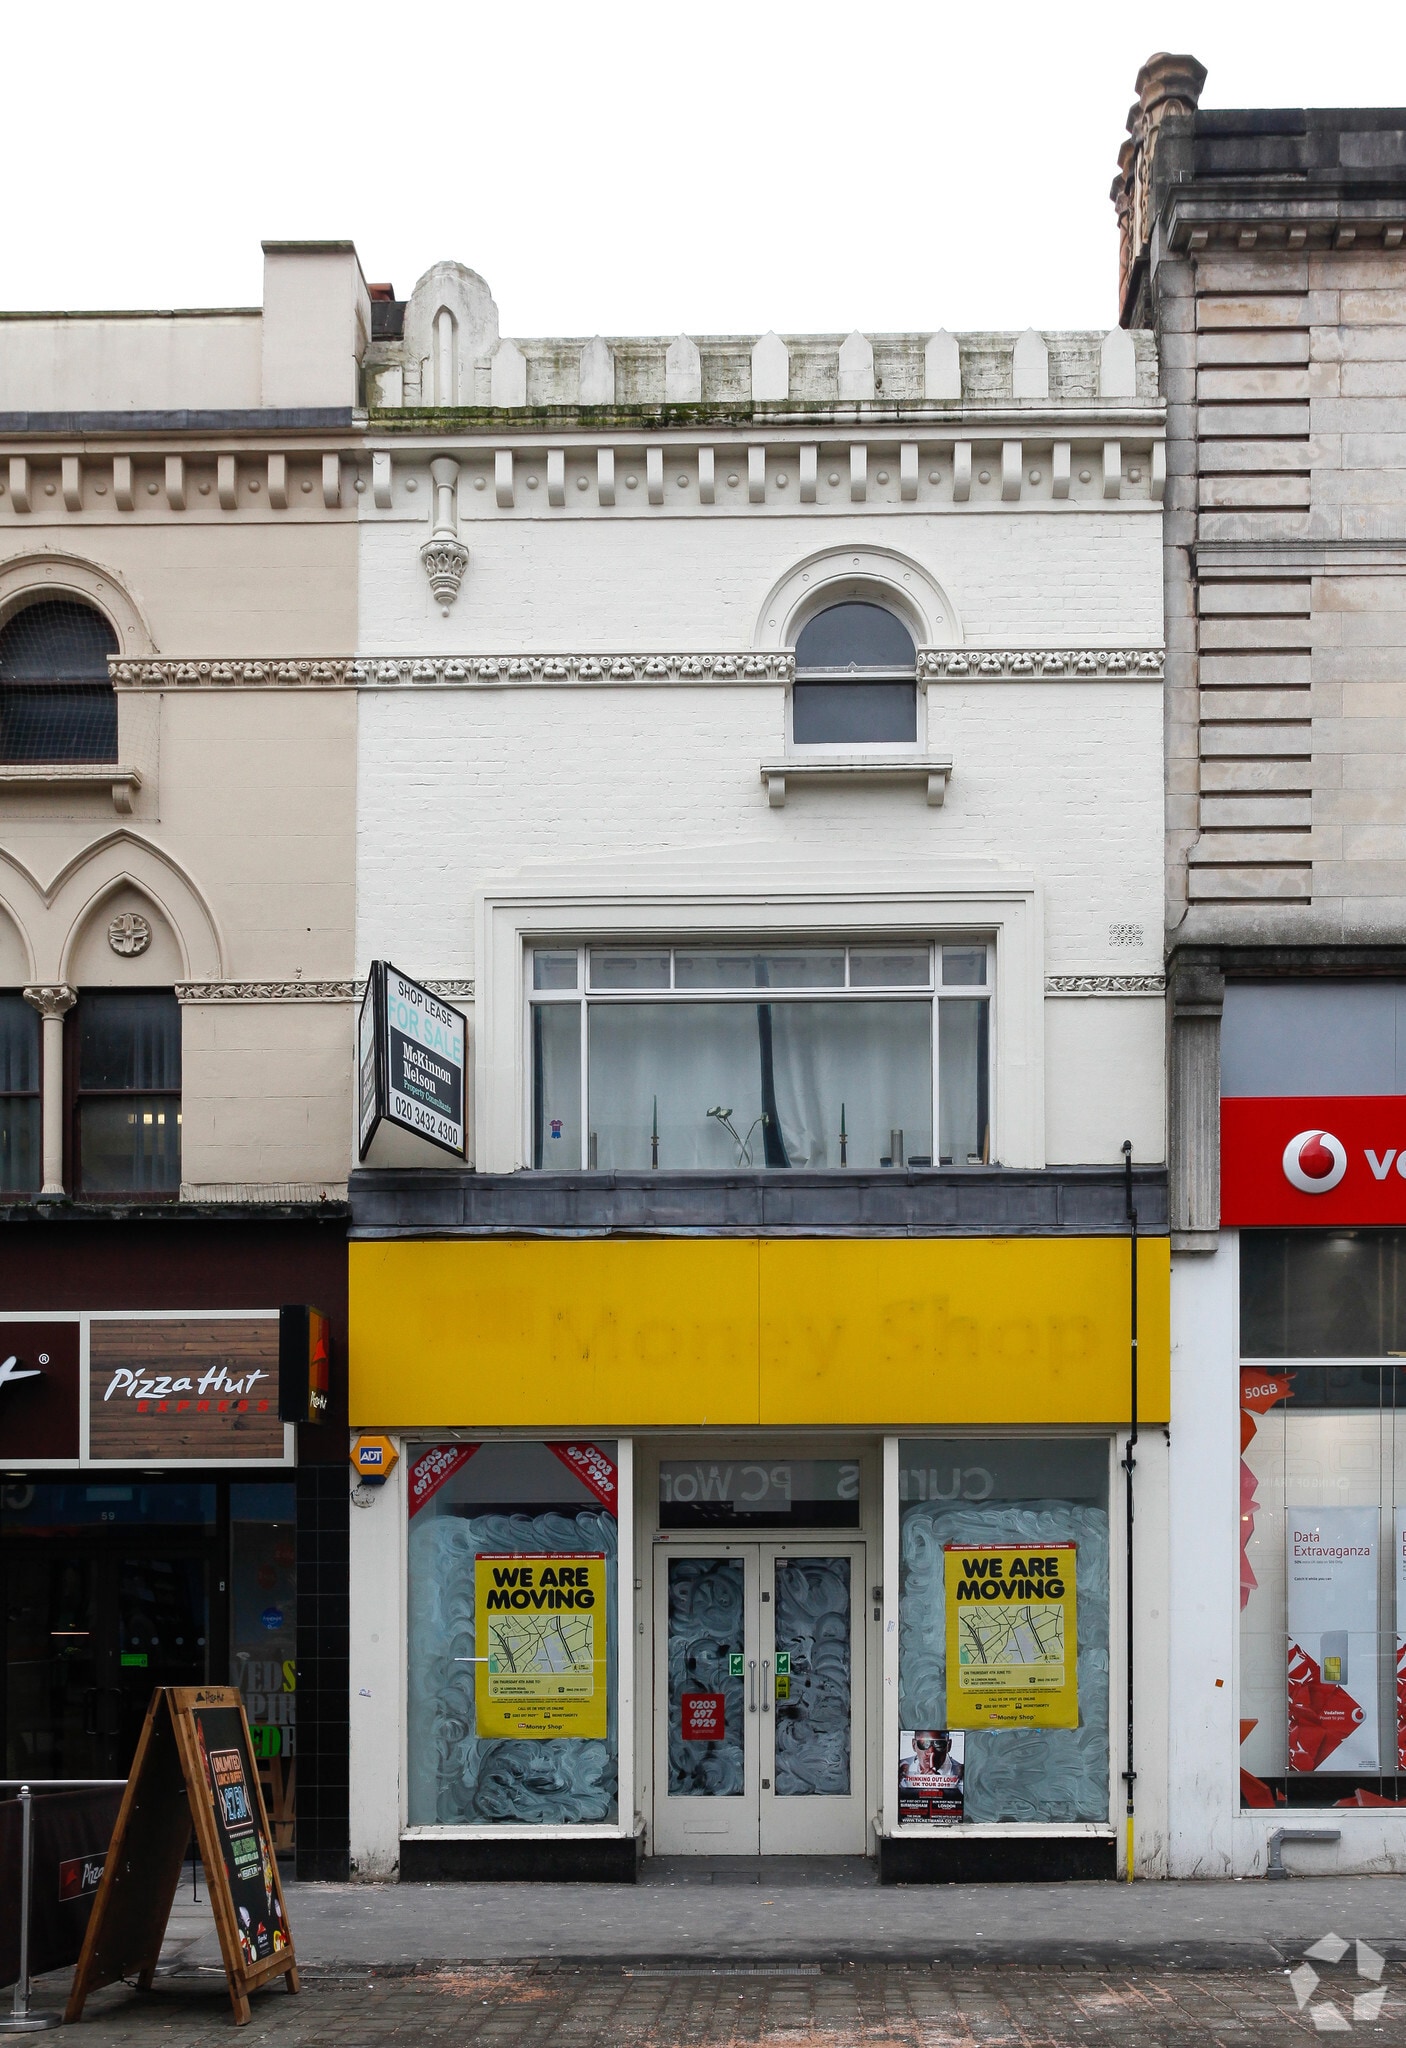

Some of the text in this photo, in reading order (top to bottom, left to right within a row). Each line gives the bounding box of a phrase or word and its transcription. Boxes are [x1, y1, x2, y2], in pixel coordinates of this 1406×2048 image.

[398, 981, 453, 1028] SHOP LEASE
[388, 994, 461, 1063] FOR SALE
[402, 1041, 452, 1085] McKinnon
[403, 1060, 436, 1095] Nelson
[403, 1080, 426, 1101] Property
[396, 1096, 458, 1146] 020 3432 4300
[548, 1294, 1102, 1379] Money Shop
[104, 1365, 270, 1401] Pizza Hut
[1244, 1382, 1278, 1400] 50GB
[137, 1400, 270, 1413] EXPRESS
[360, 1448, 382, 1464] ADT
[414, 1449, 442, 1478] 0203
[585, 1447, 612, 1476] 0203
[413, 1473, 434, 1496] 697
[431, 1447, 458, 1475] 9929
[566, 1446, 589, 1466] 697
[587, 1465, 615, 1492] 9929
[101, 1511, 116, 1521] 59
[1294, 1531, 1320, 1543] Data
[1294, 1545, 1371, 1559] Extravaganza
[492, 1567, 589, 1588] WE ARE
[962, 1557, 1059, 1579] WE ARE
[486, 1588, 595, 1610] MOVING
[956, 1578, 1065, 1600] MOVING
[689, 1700, 717, 1710] 0203
[693, 1710, 713, 1719] 697
[689, 1718, 717, 1728] 9929
